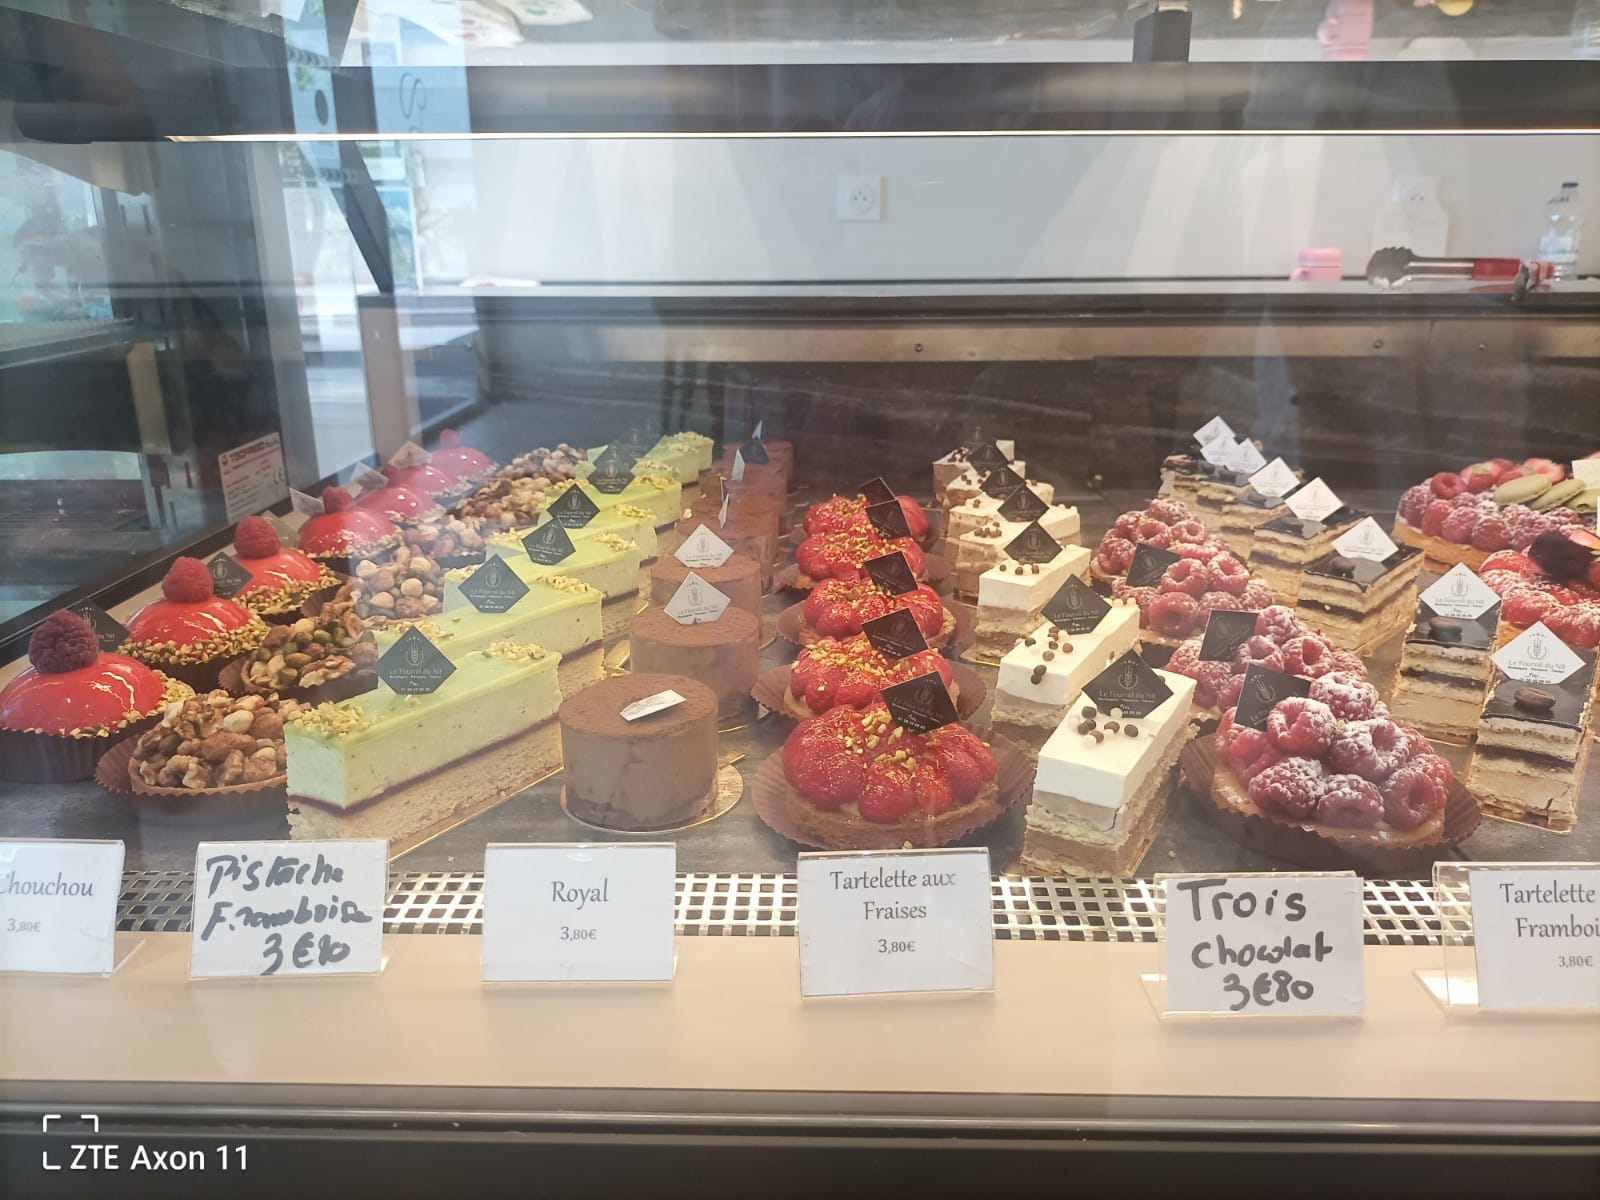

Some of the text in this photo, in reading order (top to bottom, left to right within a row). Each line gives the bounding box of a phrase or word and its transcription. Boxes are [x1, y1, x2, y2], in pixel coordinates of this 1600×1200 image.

[829, 866, 957, 890] Tartelette aux
[551, 877, 609, 910] Royal
[1176, 878, 1307, 922] Trois
[1499, 880, 1596, 904] Tartelette
[864, 901, 927, 920] Fraises
[8, 918, 42, 933] 3,80€
[560, 926, 598, 942] 3,80€
[878, 938, 916, 954] 3,80€
[1557, 955, 1594, 968] 3,80€
